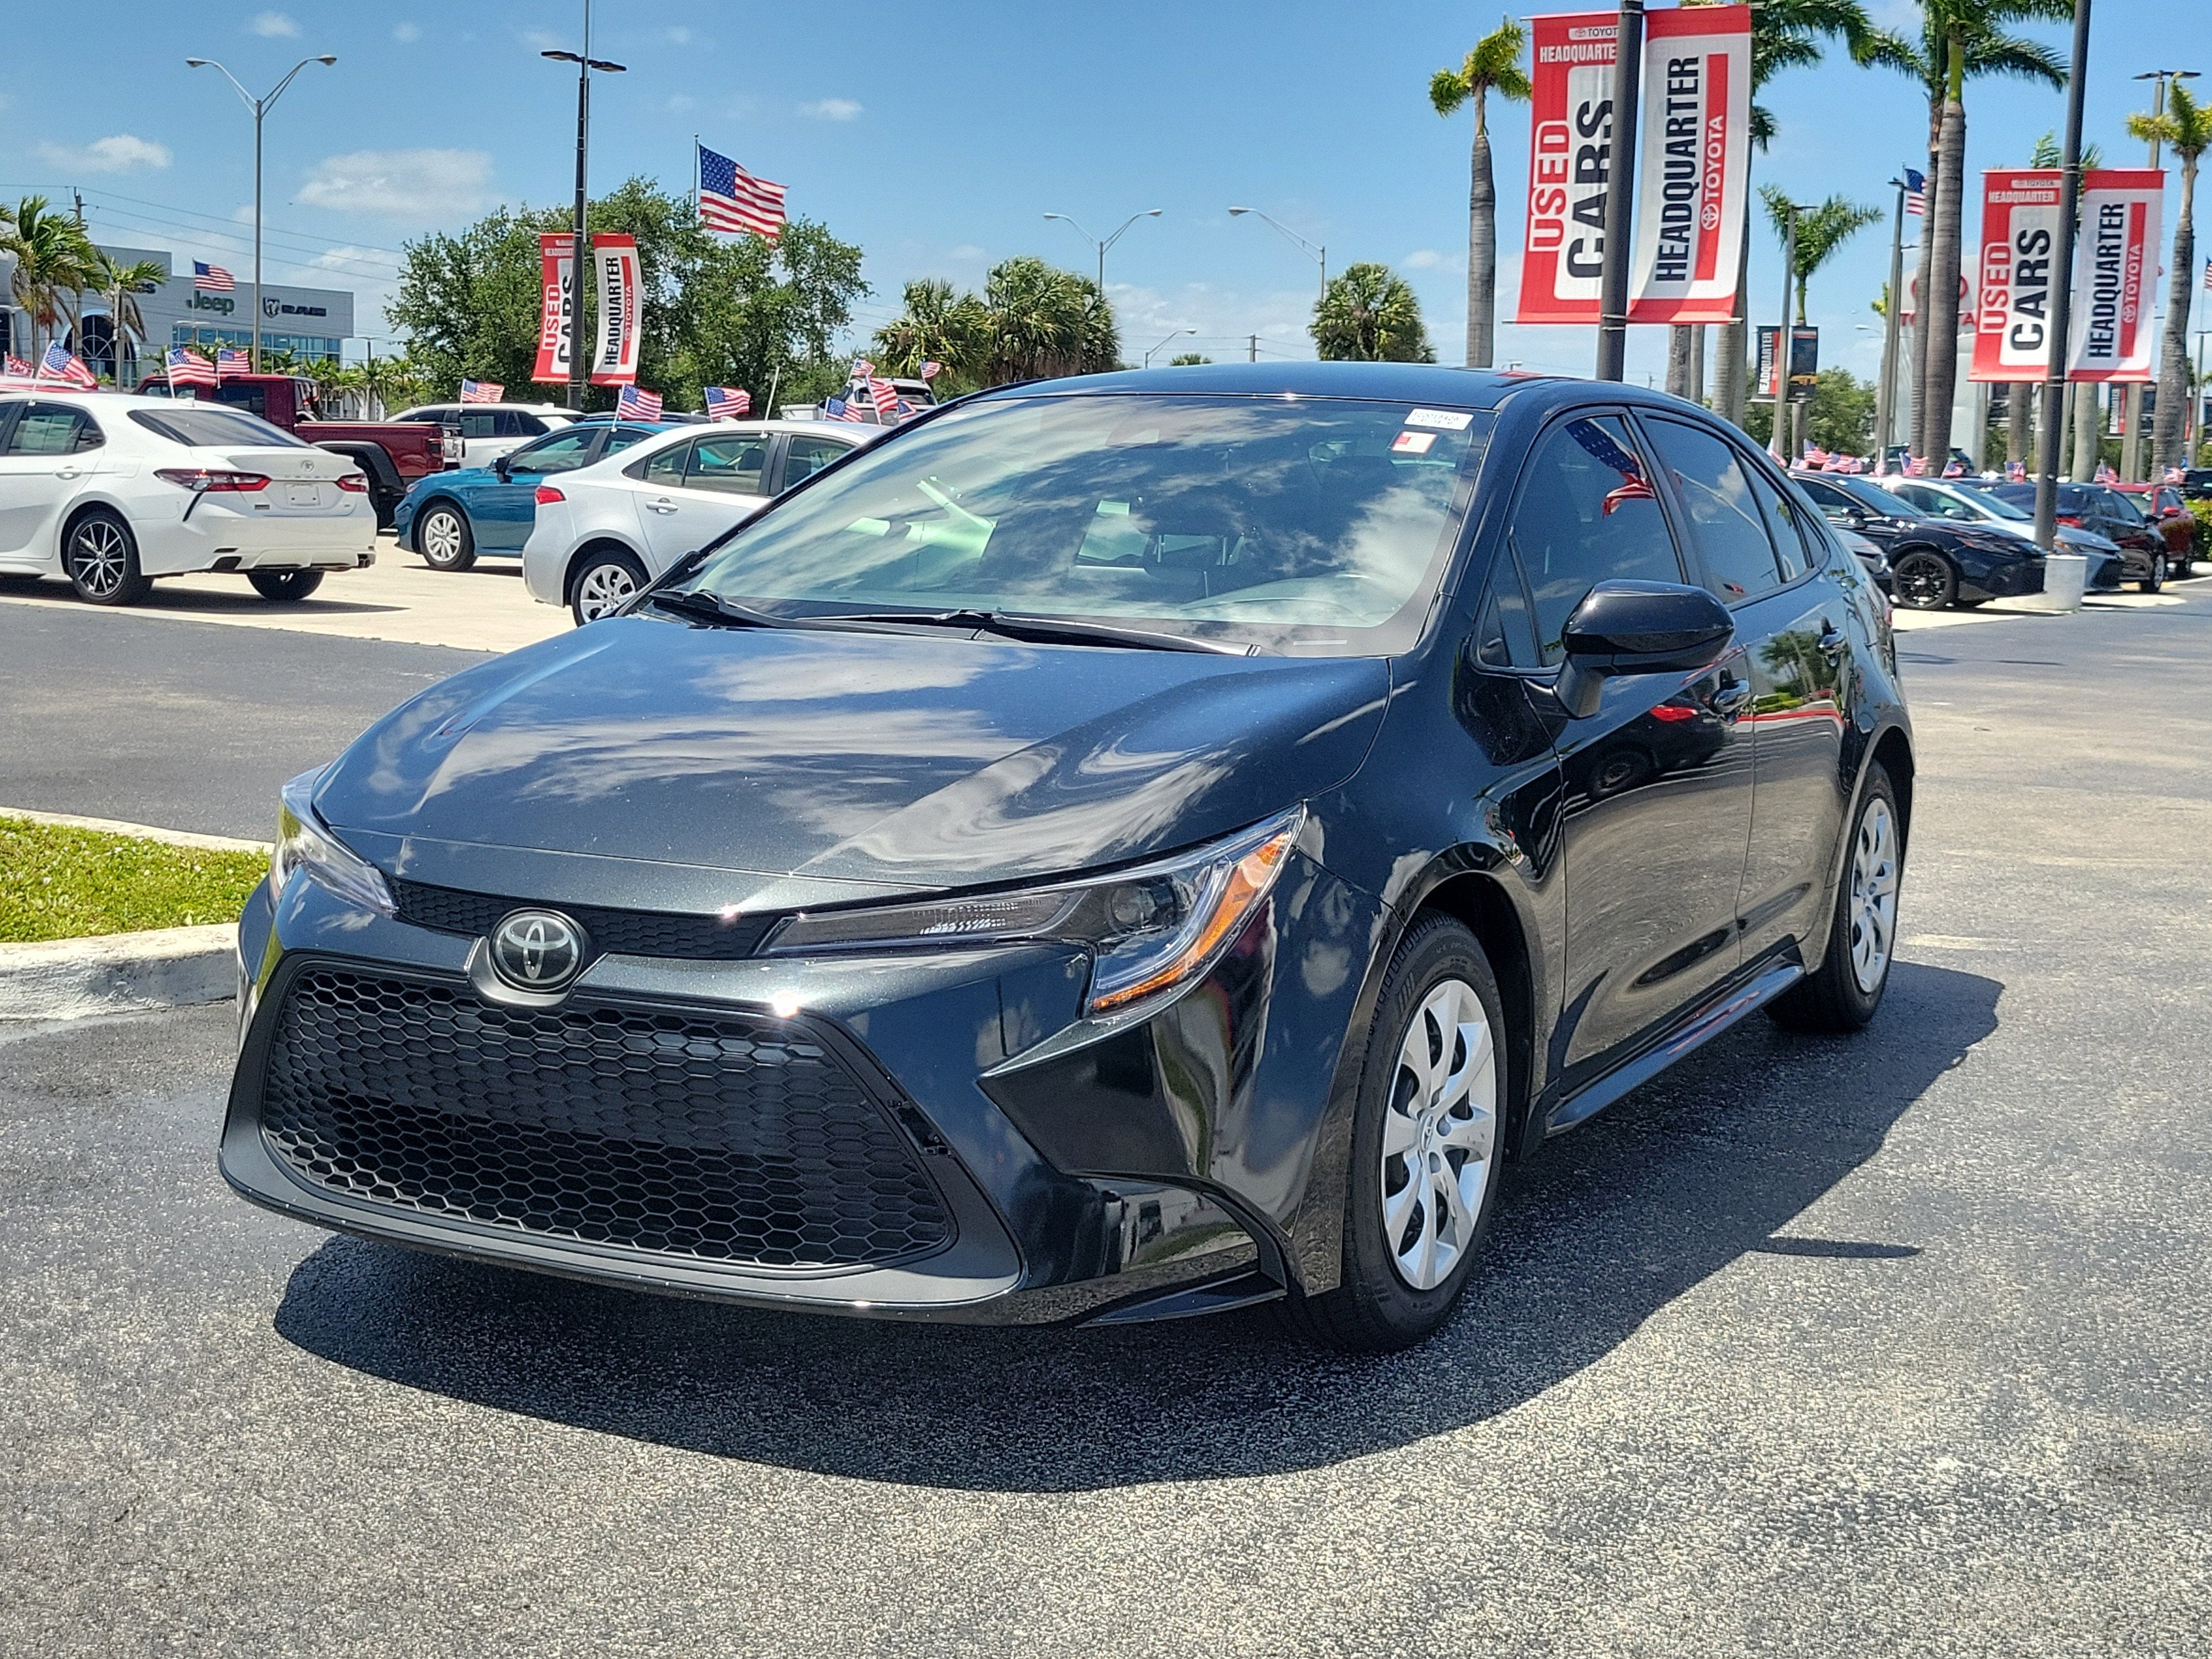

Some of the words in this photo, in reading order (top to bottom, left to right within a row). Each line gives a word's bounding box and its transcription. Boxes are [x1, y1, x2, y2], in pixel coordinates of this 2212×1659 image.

[1539, 43, 1616, 63] HEADQUARTE
[1588, 27, 1618, 37] TOYOT
[1531, 123, 1570, 250] USED
[1567, 99, 1613, 278] CARS
[1655, 56, 1700, 281] HEADQUARTER
[1705, 115, 1724, 202] TOYOTA
[185, 290, 235, 317] Jeep
[604, 257, 623, 365] HEADQUARTER
[1980, 244, 2011, 331] USED
[2010, 229, 2051, 351] CARS
[2087, 203, 2124, 358] HEADQUARTER
[2124, 244, 2141, 302] TOYOTA
[543, 286, 561, 348] USED
